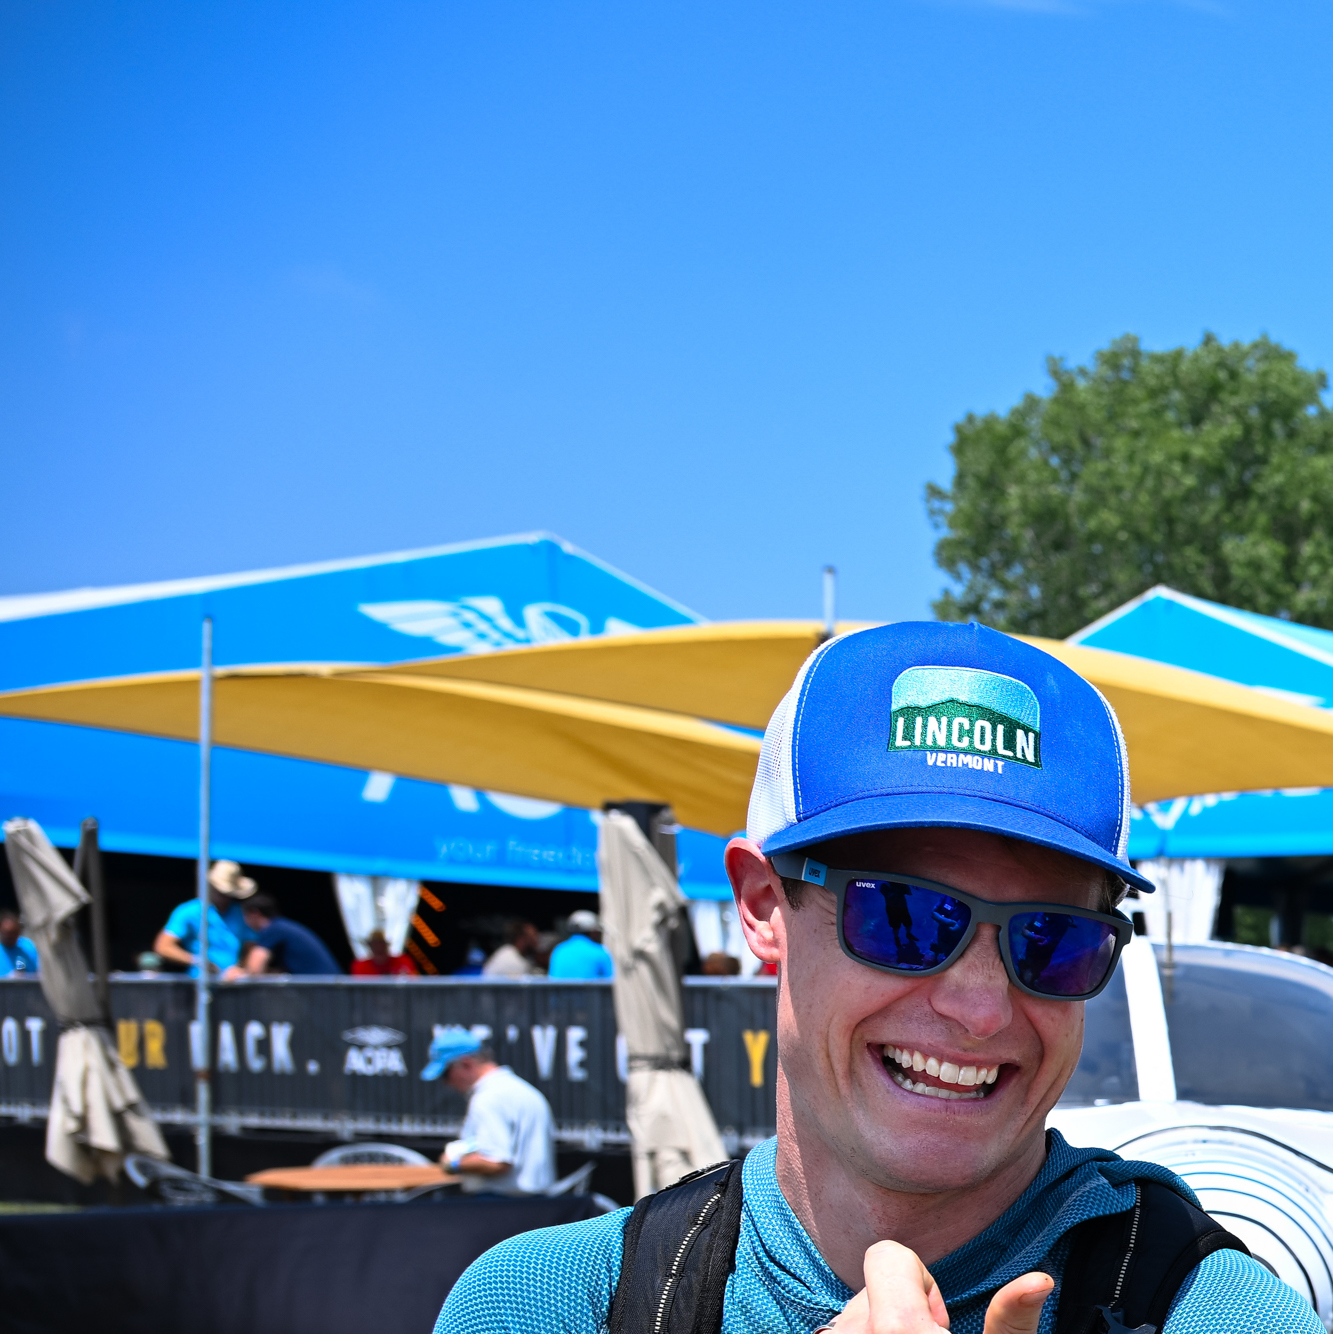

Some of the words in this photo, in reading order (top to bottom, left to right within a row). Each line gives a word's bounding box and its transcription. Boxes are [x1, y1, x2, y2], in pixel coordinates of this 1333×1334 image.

[894, 715, 1036, 763] LINCOLN
[926, 751, 1005, 774] VERMONT
[855, 881, 876, 889] uvex
[344, 1046, 408, 1078] AOPA
